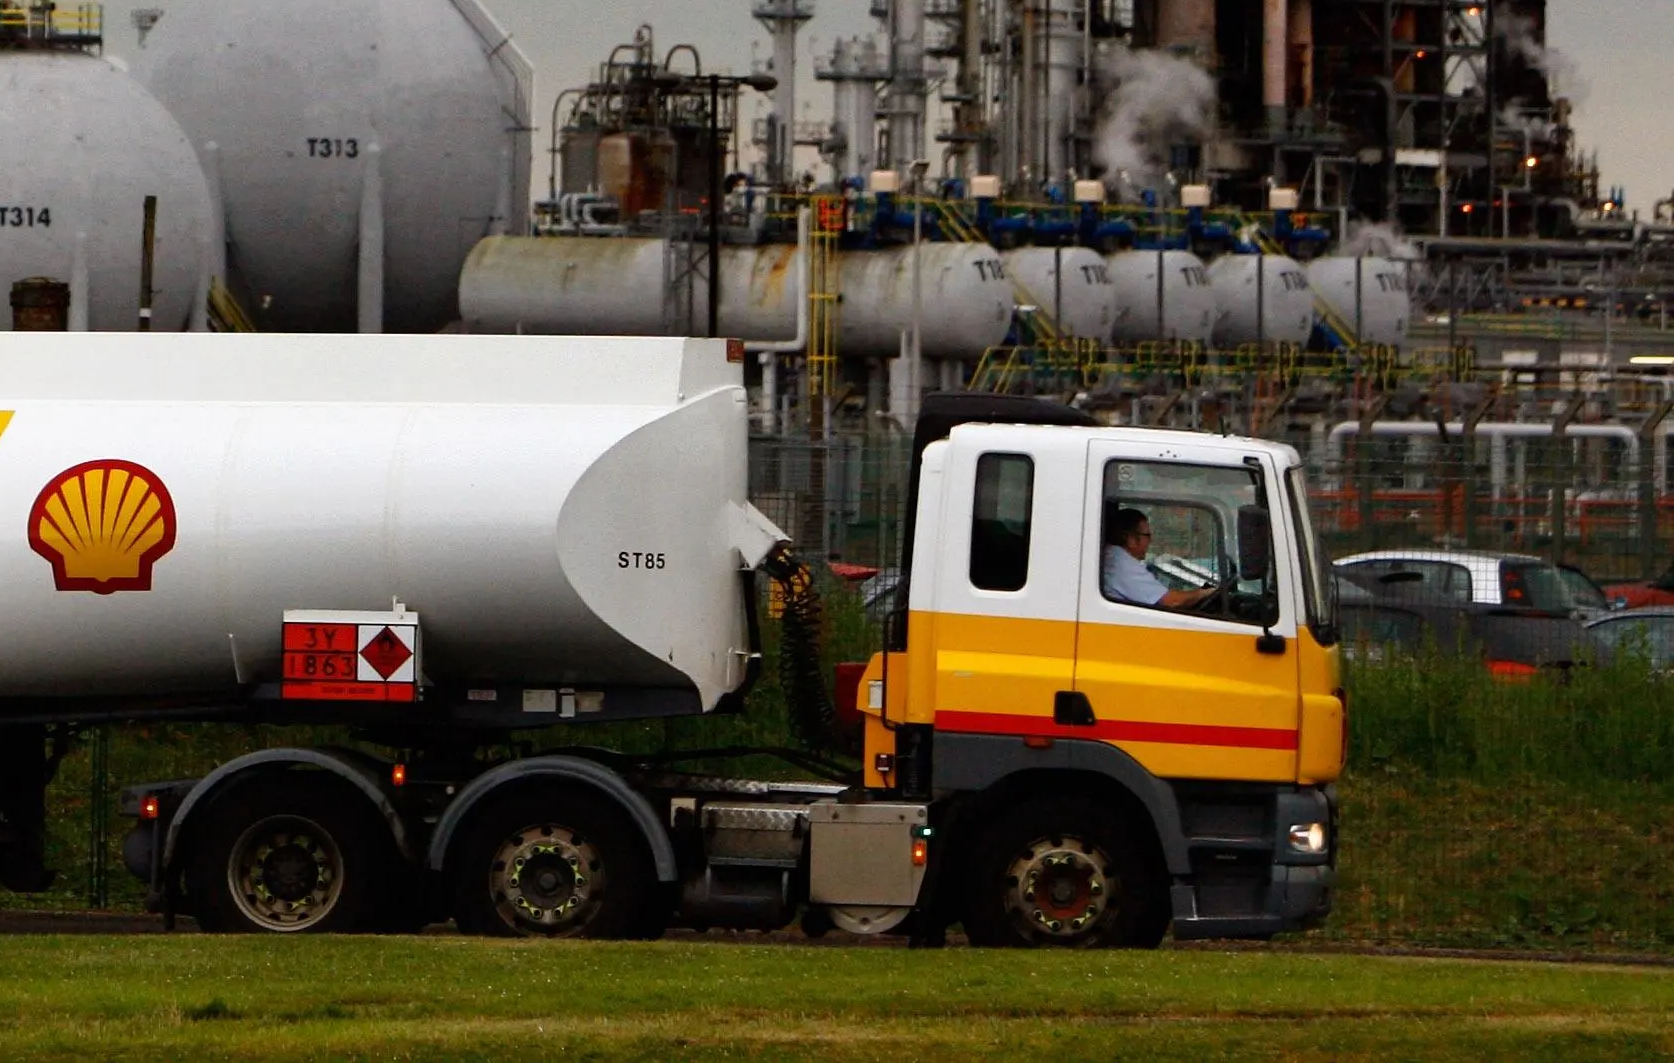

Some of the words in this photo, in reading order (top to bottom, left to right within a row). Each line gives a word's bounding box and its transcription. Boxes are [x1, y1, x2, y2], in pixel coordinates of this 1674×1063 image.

[307, 138, 358, 158] T313
[618, 551, 665, 569] ST85
[304, 627, 338, 649] 3Y
[289, 654, 354, 676] 1863
